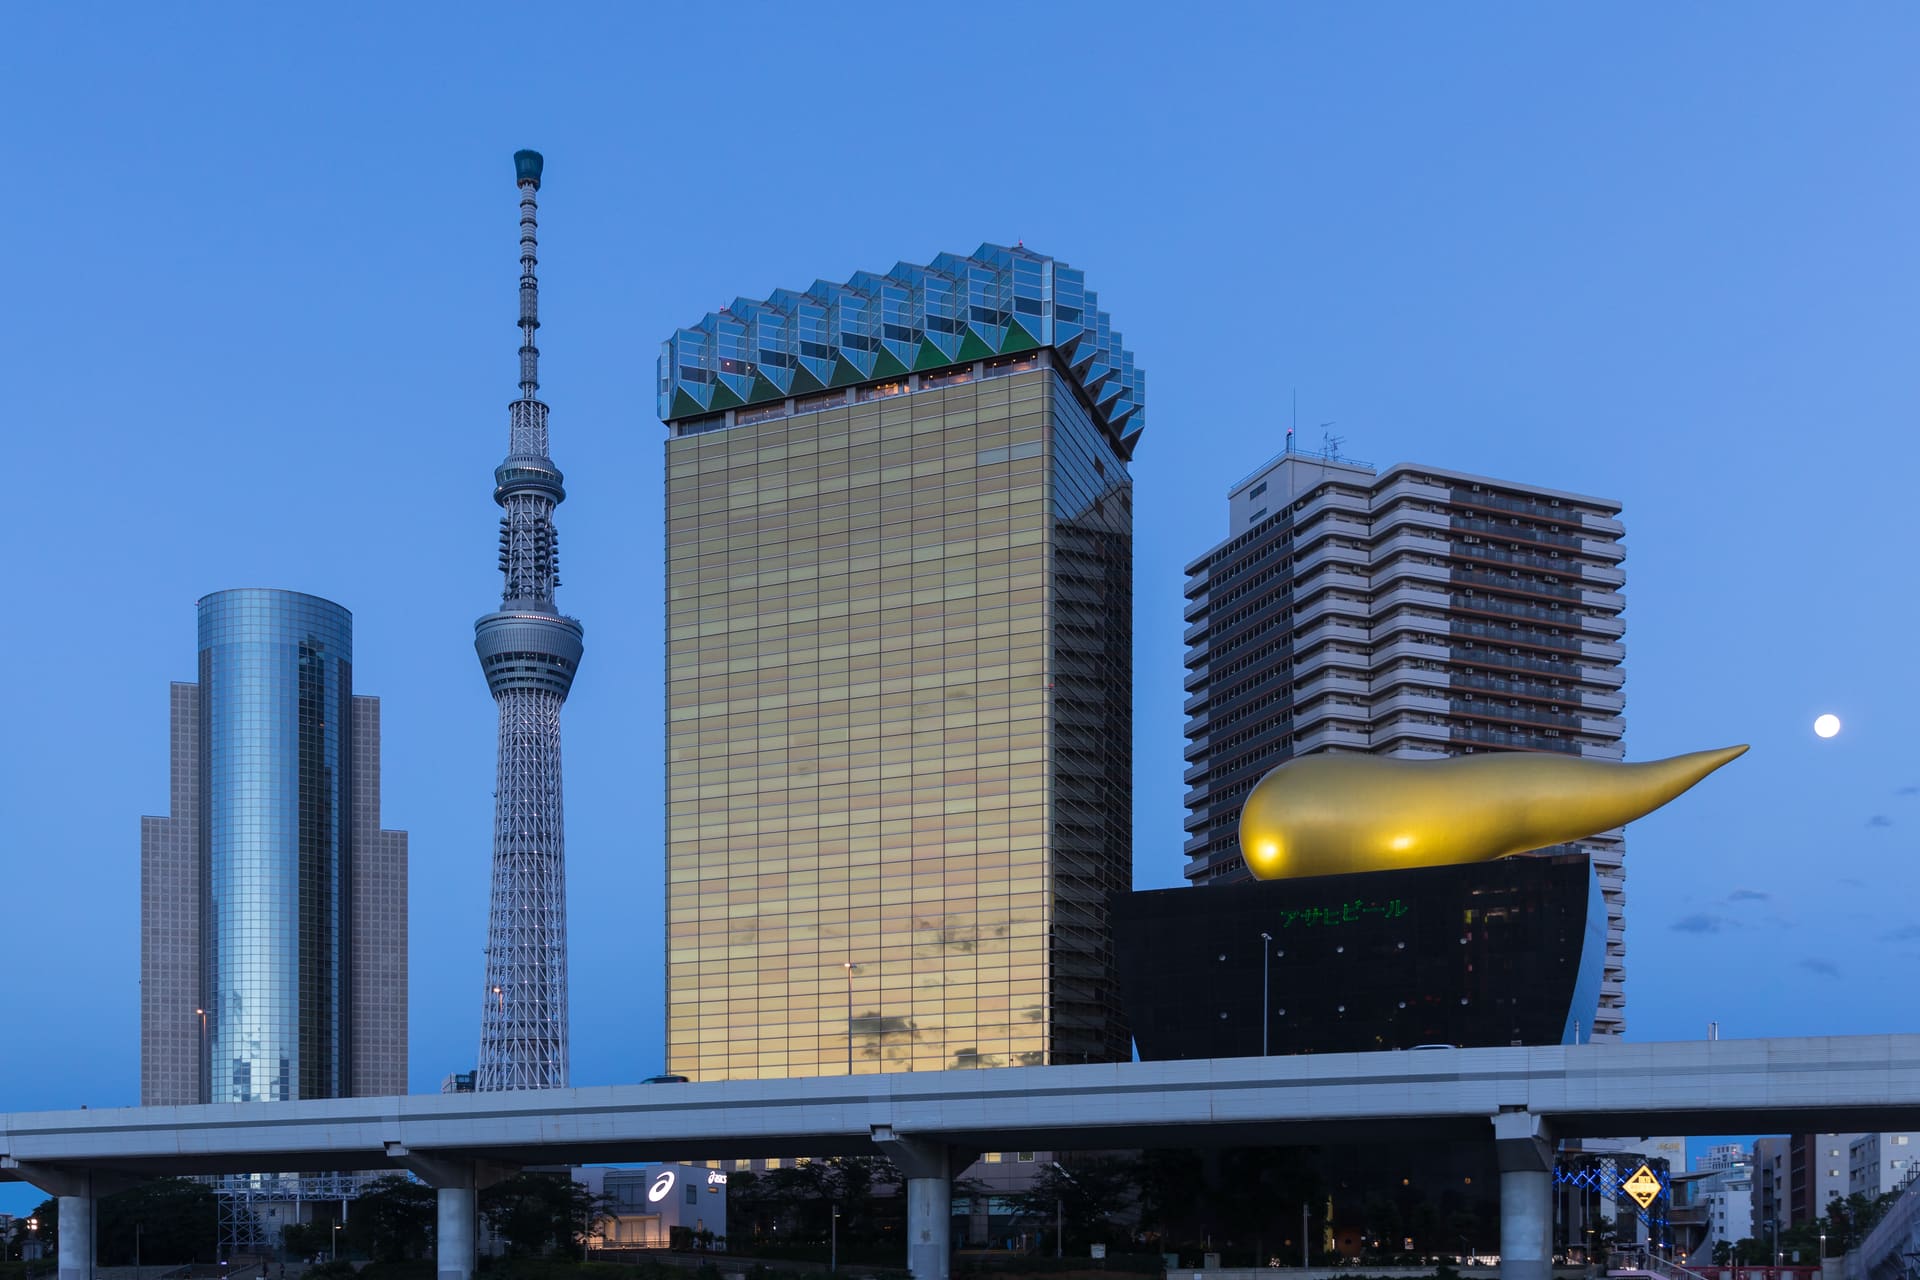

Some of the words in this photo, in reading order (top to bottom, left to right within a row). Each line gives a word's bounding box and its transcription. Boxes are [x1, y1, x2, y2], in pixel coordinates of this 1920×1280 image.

[1280, 899, 1408, 928] アサヒビール
